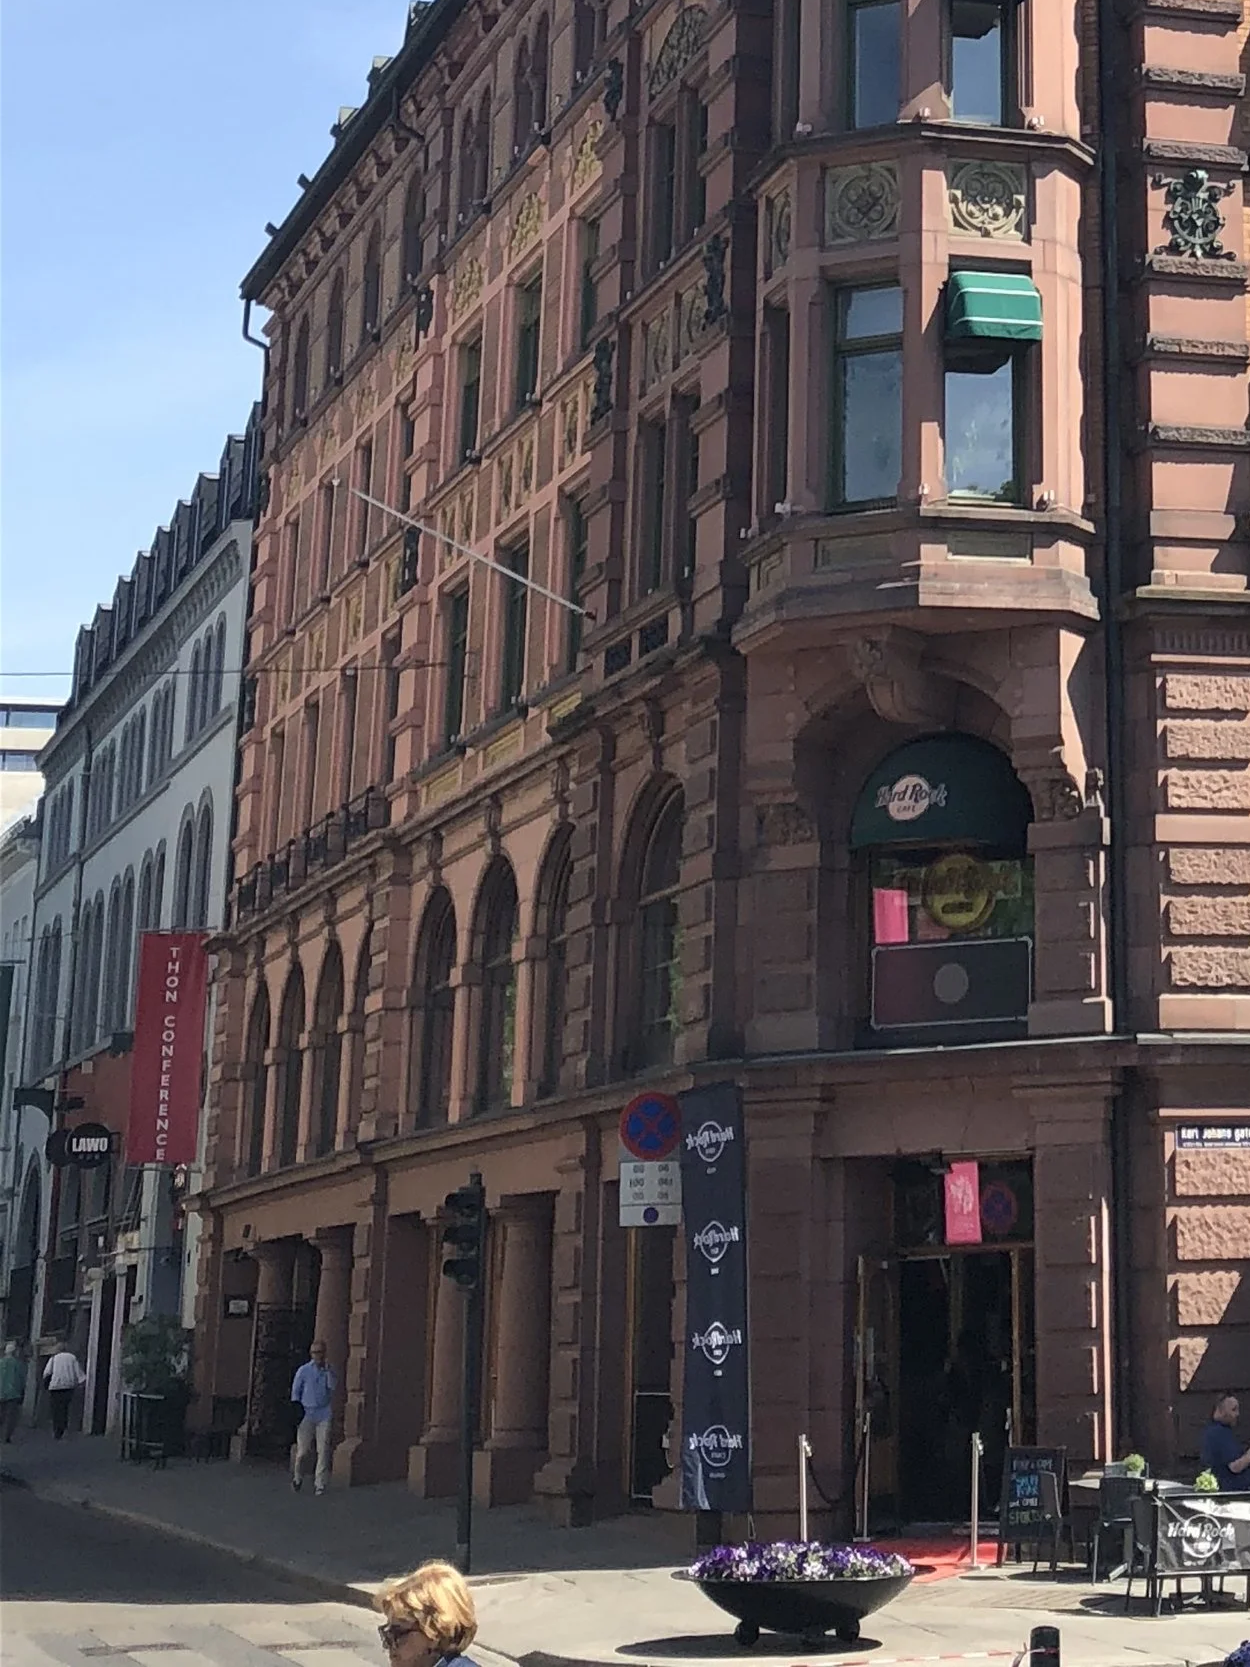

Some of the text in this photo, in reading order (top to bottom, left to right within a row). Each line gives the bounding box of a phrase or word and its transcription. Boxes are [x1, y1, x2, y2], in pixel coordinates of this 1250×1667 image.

[875, 782, 948, 807] Hard Rock
[156, 947, 180, 1161] THON CONFERENCE
[72, 1137, 108, 1152] LAWO
[1168, 1522, 1235, 1541] Hard Rock
